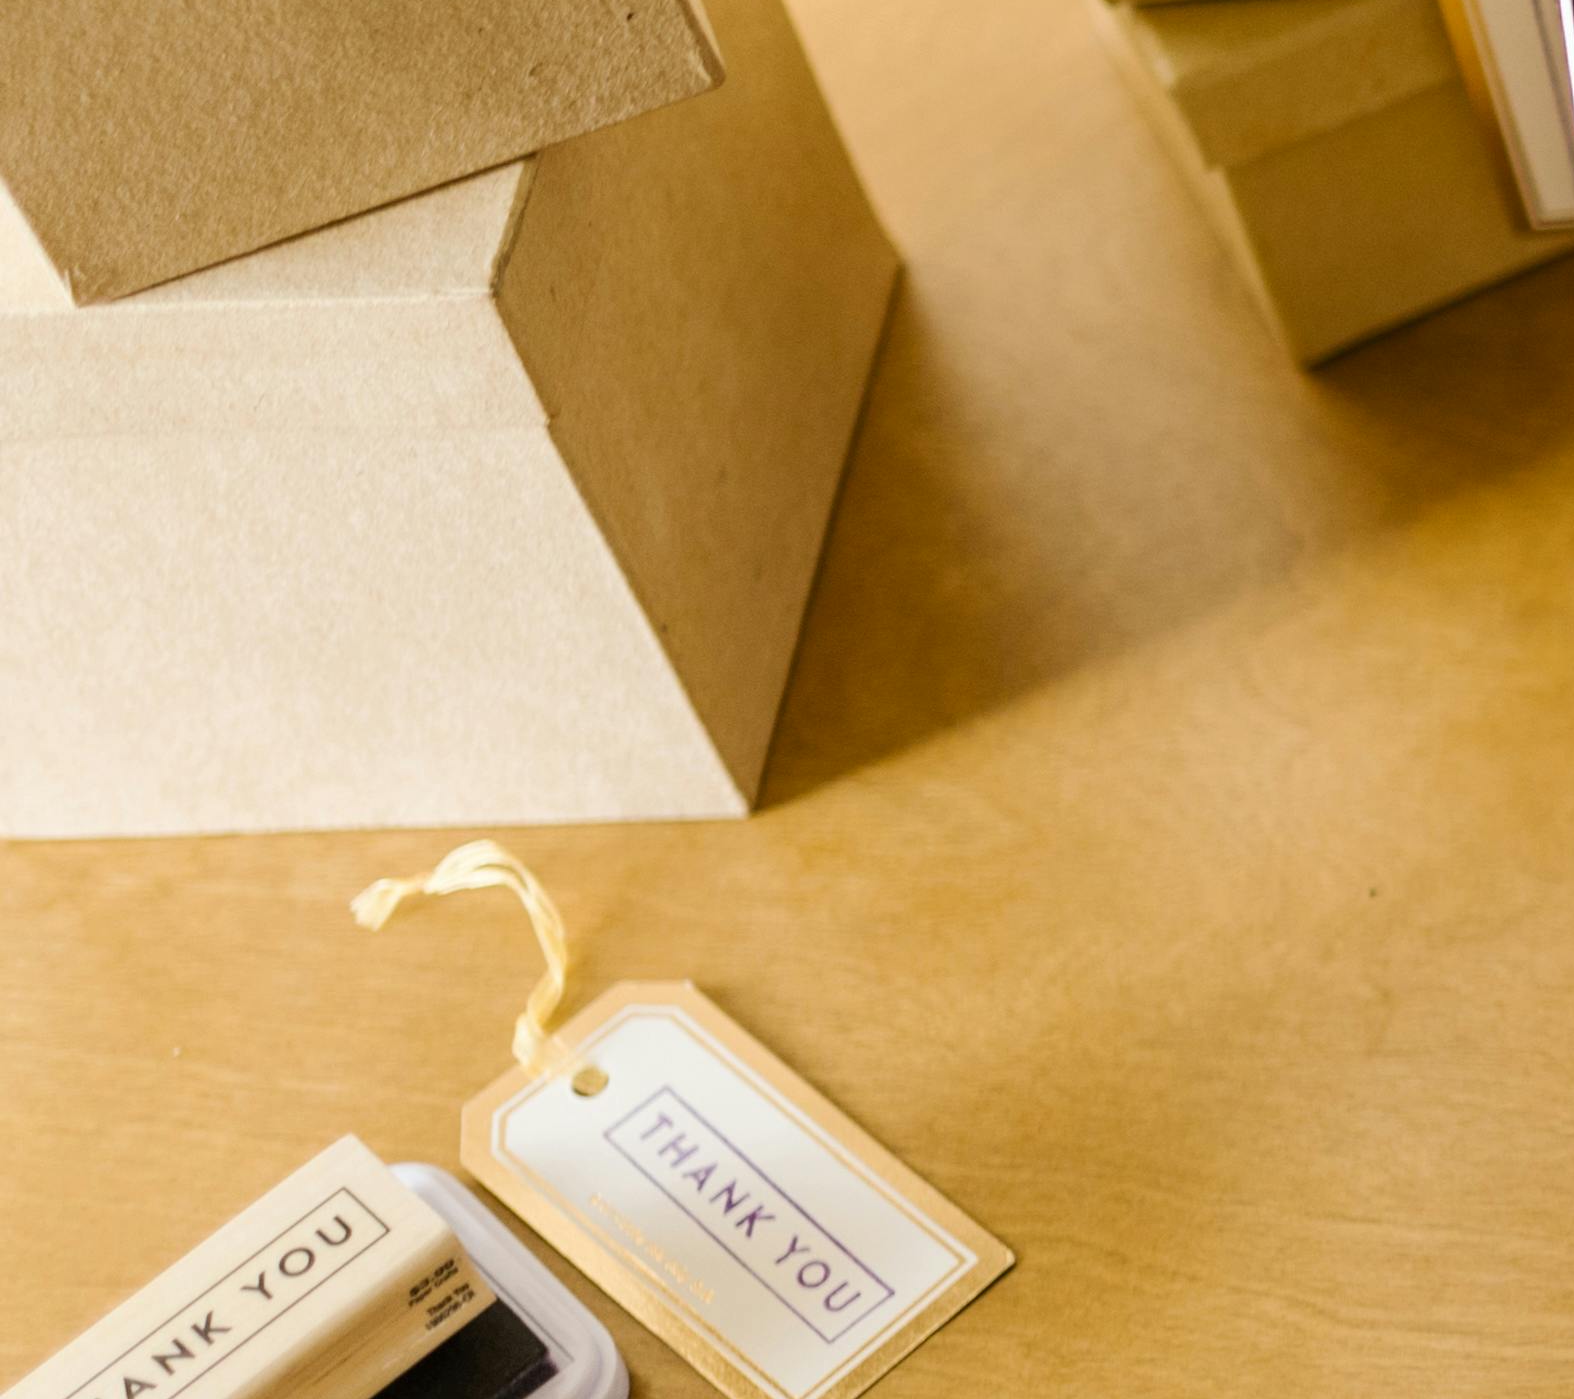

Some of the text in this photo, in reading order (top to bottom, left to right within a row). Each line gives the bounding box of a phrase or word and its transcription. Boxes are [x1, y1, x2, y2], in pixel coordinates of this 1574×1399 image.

[241, 1216, 353, 1302] YOU
[637, 1111, 777, 1242] THANK
[773, 1238, 862, 1320] YOU
